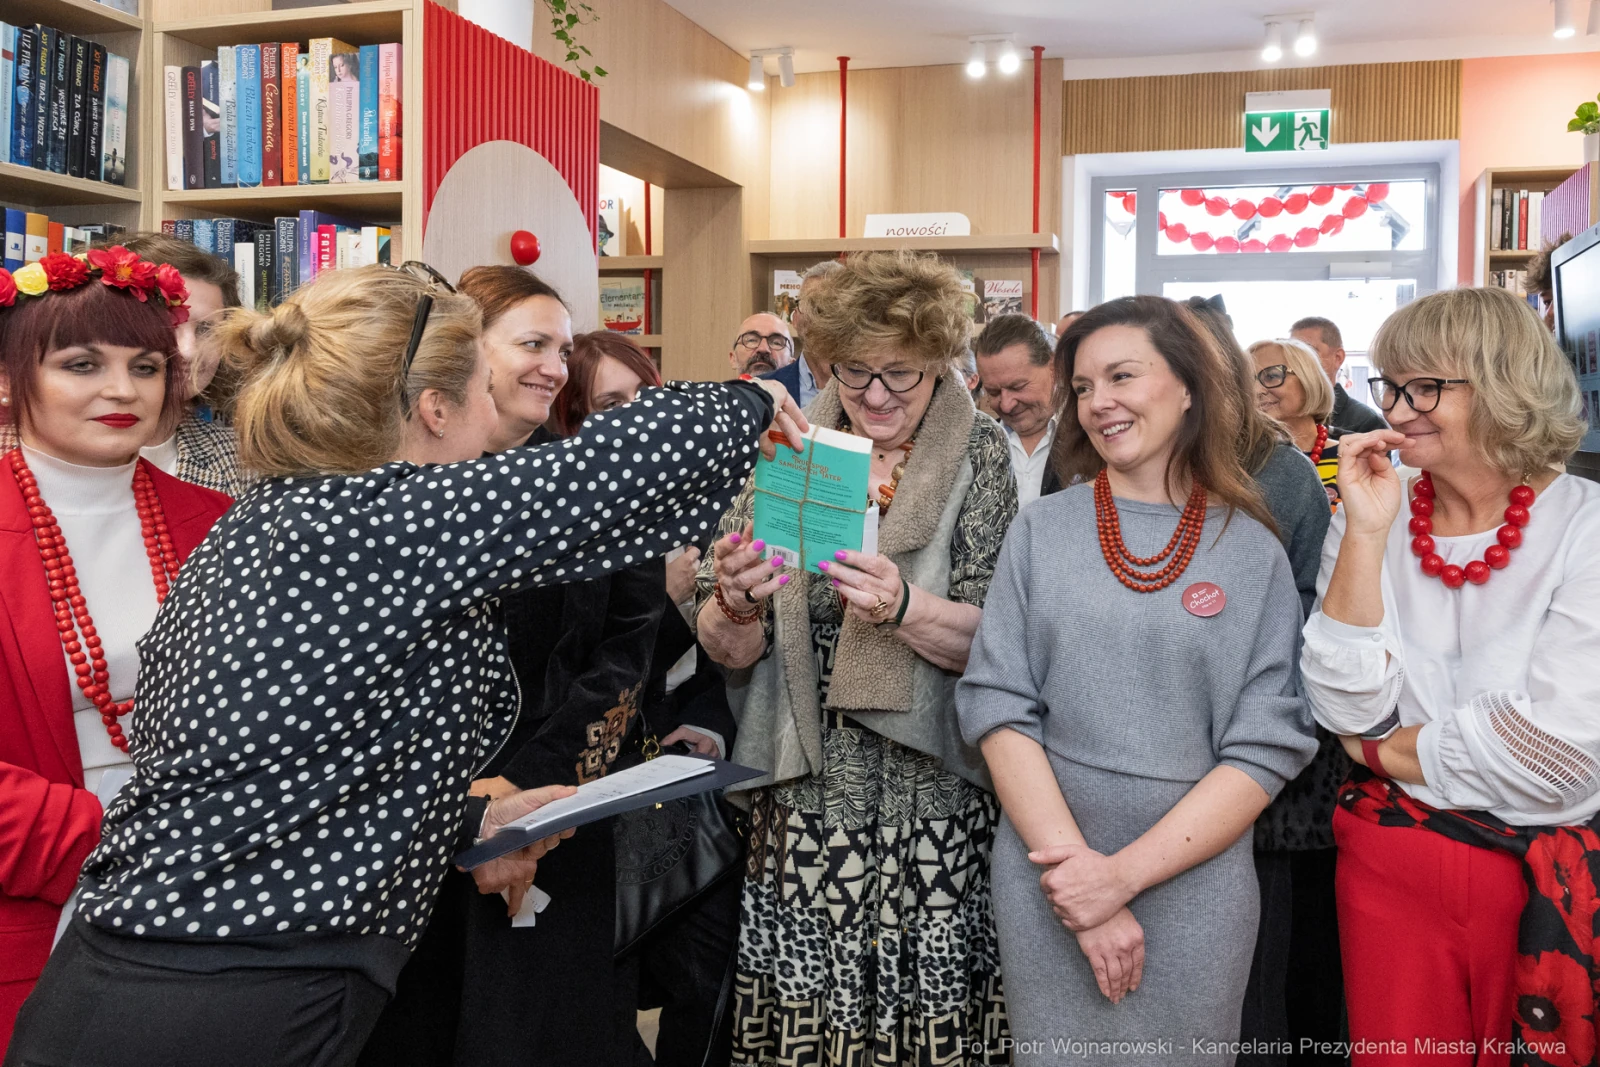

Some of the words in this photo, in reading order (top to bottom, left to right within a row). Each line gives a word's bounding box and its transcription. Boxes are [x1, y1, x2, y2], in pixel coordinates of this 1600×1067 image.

[22, 33, 31, 49] LIZ
[20, 49, 30, 94] FIELDING
[57, 53, 65, 81] FIELDING
[75, 59, 83, 87] FIELDING
[241, 47, 249, 79] GREGORY
[320, 43, 328, 74] PHILIPPA
[383, 52, 393, 78] Philippa
[92, 64, 100, 92] FIELDING
[168, 71, 177, 99] GREELEY
[187, 71, 196, 99] GREELEY
[383, 78, 393, 103] Gregory
[245, 84, 256, 121] Błazen
[264, 83, 279, 152] Czarownica
[287, 84, 296, 131] Czerwona
[73, 111, 81, 136] CÓRKA
[345, 111, 353, 140] GREGORY
[363, 107, 376, 147] Mokradła
[244, 125, 256, 165] królowej
[288, 133, 297, 168] królowa
[599, 199, 614, 210] OR
[223, 221, 231, 253] PHILIPPA
[279, 220, 287, 253] GREGORY
[286, 221, 294, 253] PHILIPPA
[886, 222, 948, 236] nowości
[321, 233, 330, 269] FATUM
[985, 280, 1020, 293] Wesele
[653, 811, 698, 875] COUTURE
